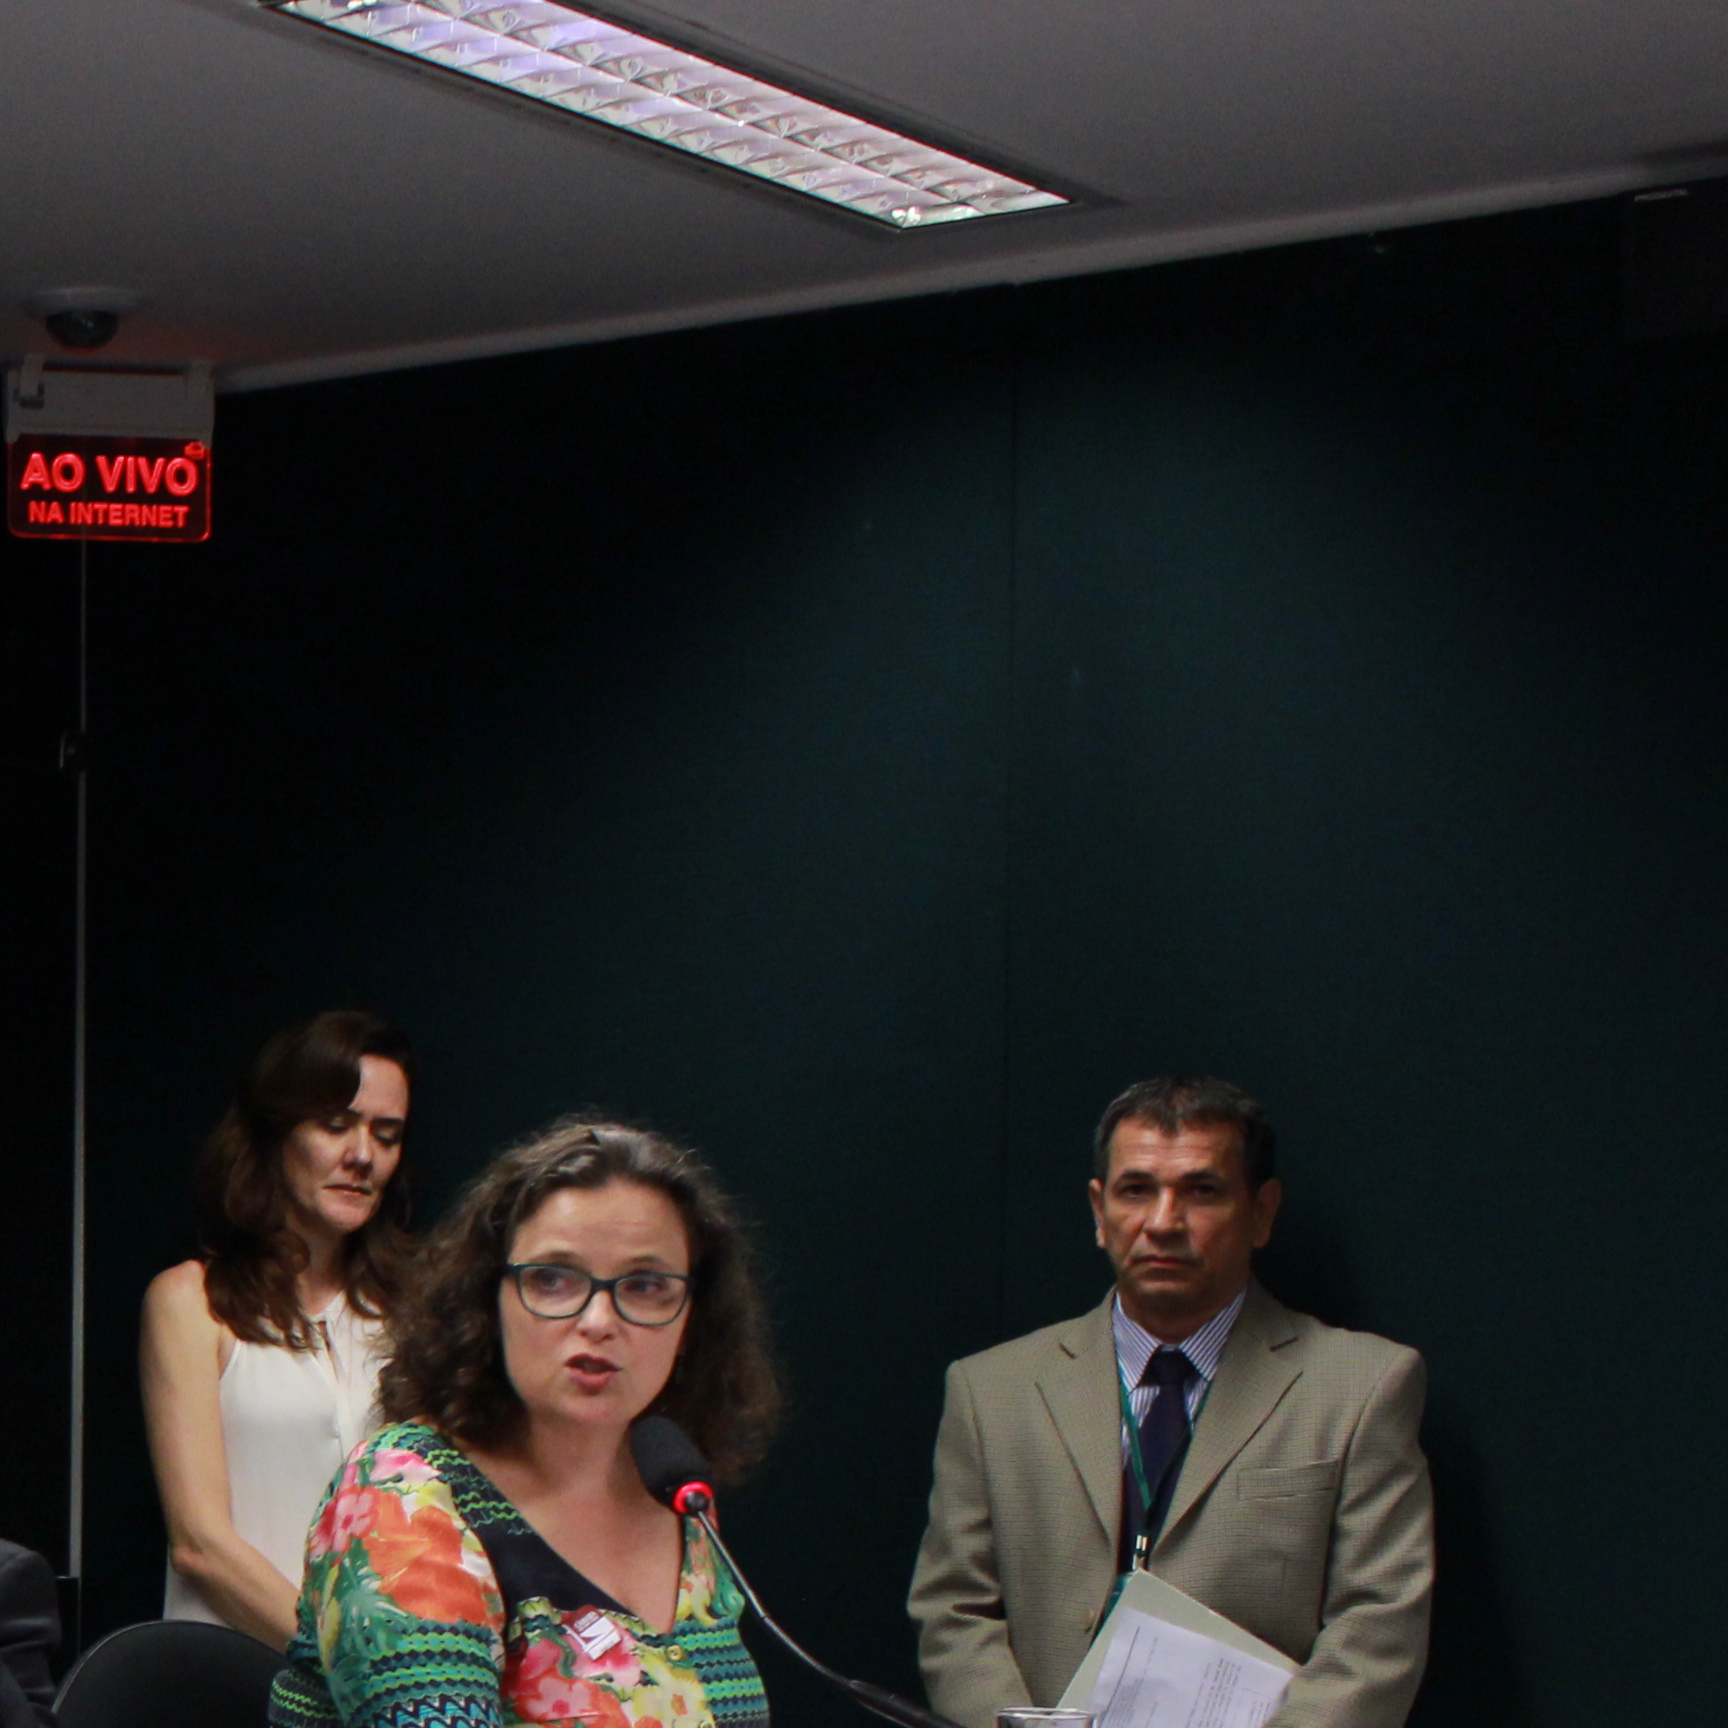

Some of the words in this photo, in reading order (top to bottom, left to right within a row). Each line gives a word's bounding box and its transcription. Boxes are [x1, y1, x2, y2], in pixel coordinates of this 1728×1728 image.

[19, 452, 86, 493] AO
[95, 455, 199, 497] VIVO
[28, 501, 65, 524] NA
[69, 502, 190, 528] INTERNET
